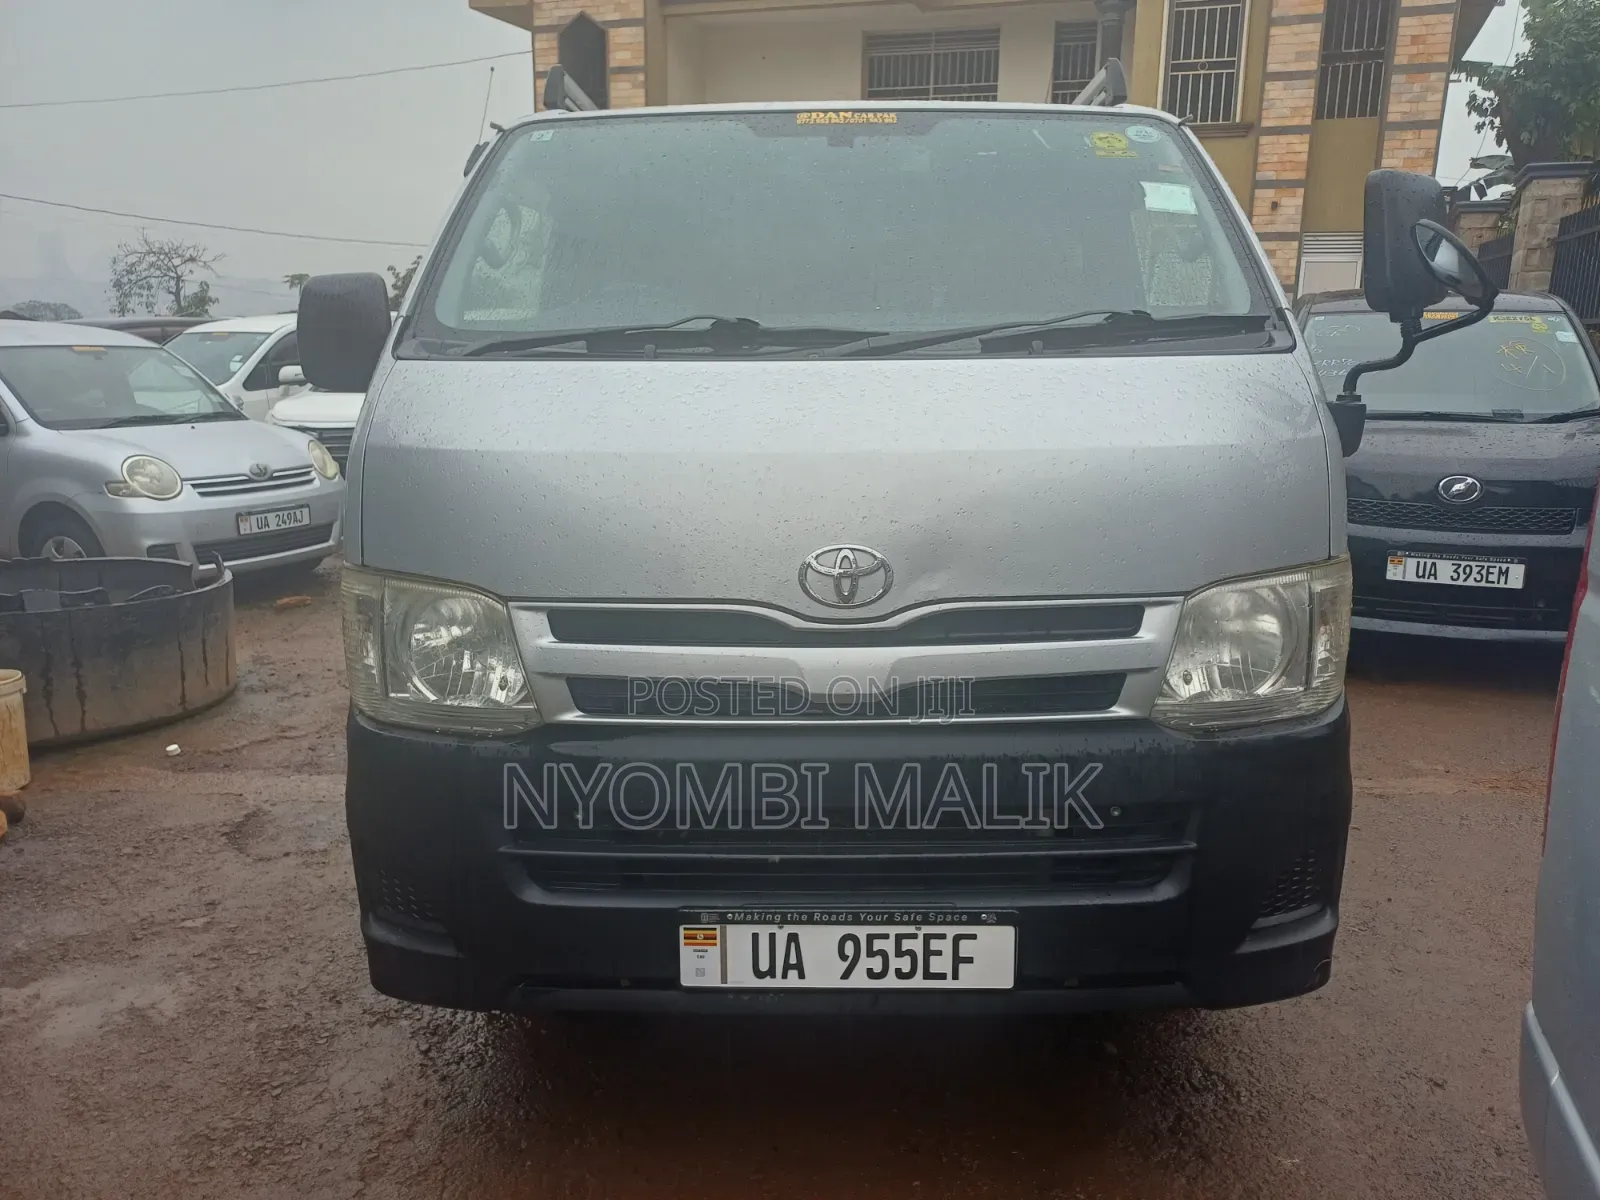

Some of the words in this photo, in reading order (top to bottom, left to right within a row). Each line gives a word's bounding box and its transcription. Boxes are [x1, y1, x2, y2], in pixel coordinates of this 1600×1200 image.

[811, 111, 853, 119] DAN
[256, 515, 270, 530] UA
[275, 510, 304, 527] 249AJ
[1415, 560, 1438, 581] UA
[1450, 562, 1511, 586] 393EM
[734, 912, 781, 923] Making
[787, 912, 808, 921] the
[813, 912, 853, 921] Roads
[859, 912, 889, 921] Your
[894, 912, 923, 921] Safe
[928, 912, 968, 923] Space
[751, 932, 806, 980] UA
[837, 932, 978, 981] 955EF
